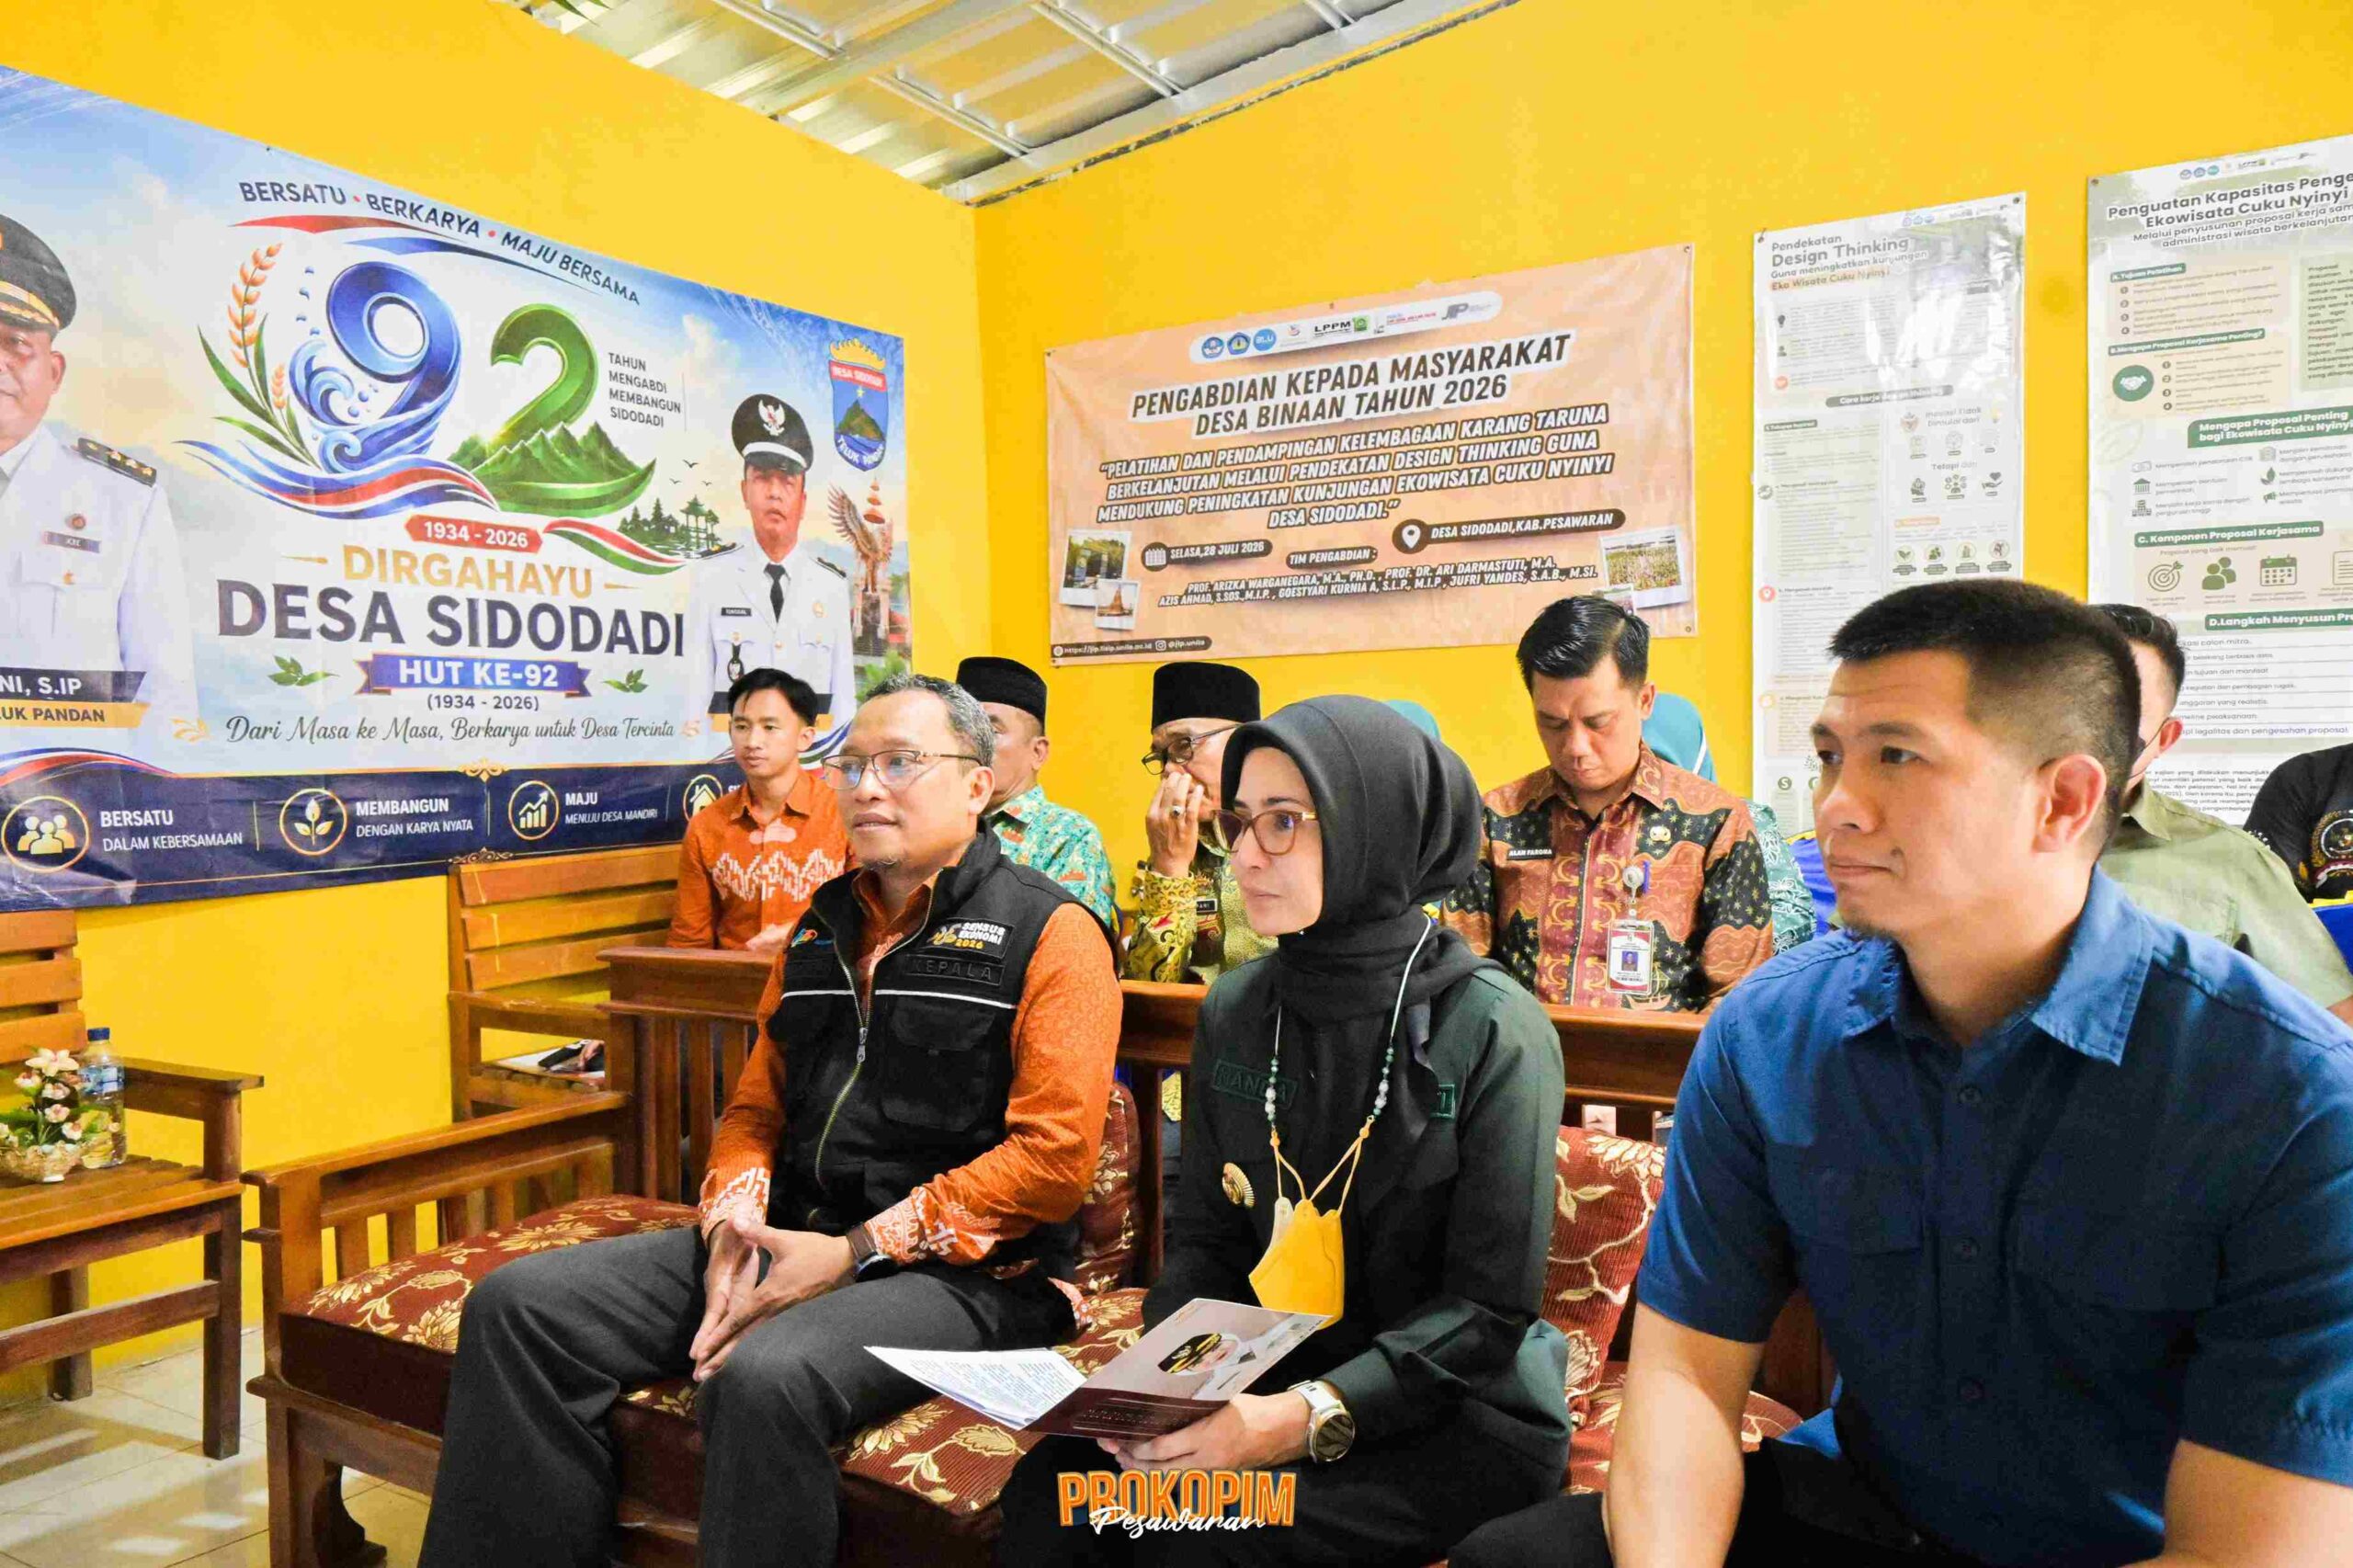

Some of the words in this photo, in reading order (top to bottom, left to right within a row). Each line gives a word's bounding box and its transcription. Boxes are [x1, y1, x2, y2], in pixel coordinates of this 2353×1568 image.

[2109, 197, 2201, 220] Penguatan
[2205, 183, 2295, 208] Kapasitas
[2145, 207, 2234, 229] Ekowisata
[2238, 199, 2286, 214] Cuku
[2290, 186, 2349, 210] Nyinyi
[2133, 229, 2172, 242] Melalui
[2174, 220, 2243, 238] penyusunan
[2245, 212, 2295, 229] proposal
[2297, 205, 2326, 221] kerja
[240, 181, 347, 207] BERSATU
[366, 193, 480, 238] BERKARYA
[501, 230, 557, 267] MAJU
[559, 254, 642, 306] BERSAMA
[1772, 235, 1842, 252] Pendekatan
[2162, 232, 2232, 247] administrasi
[2234, 225, 2272, 238] wisata
[1772, 250, 1828, 267] Design
[1833, 238, 1909, 258] Thinking
[1771, 269, 1797, 278] Guna
[608, 352, 646, 372] TAHUN
[608, 370, 667, 394] MENGABDI
[1131, 375, 1277, 418] PENGABDIAN
[1286, 361, 1379, 397] KEPADA
[1389, 334, 1571, 383] MASYARAKAT
[608, 388, 682, 414] MEMBANGUN
[1196, 410, 1247, 437] DESA
[1256, 395, 1346, 428] BINAAN
[1355, 383, 1436, 415] TAHUN
[1443, 374, 1507, 404] 2026
[609, 406, 665, 428] SIDODADI
[2200, 419, 2251, 433] Mengapa
[2253, 415, 2302, 428] Proposal
[2304, 410, 2348, 425] Penting
[1183, 455, 1213, 471] DAN
[1216, 437, 1336, 465] PENDAMPINGAN
[1339, 426, 1455, 453] KELEMBAGAAN
[1460, 414, 1529, 440] KARANG
[1536, 404, 1608, 428] TARUNA
[2200, 429, 2224, 442] bagi
[2226, 426, 2282, 439] Ekowisata
[2284, 424, 2314, 435] Cuku
[1108, 472, 1219, 500] BERKELANJUTAN
[1223, 464, 1284, 488] MELALUI
[1288, 454, 1389, 481] PENDEKATAN
[1393, 447, 1453, 470] DESIGN
[1458, 438, 1541, 462] THINKING
[1546, 431, 1597, 452] GUNA
[1097, 498, 1183, 523] MENDUKUNG
[1188, 487, 1287, 514] PENINGKATAN
[1292, 479, 1392, 504] KUNJUNGAN
[1395, 466, 1489, 494] EKOWISATA
[1495, 461, 1543, 483] CUKU
[1548, 454, 1614, 477] NYINYI
[1268, 508, 1305, 528] DESA
[424, 521, 470, 542] 1934
[485, 527, 529, 548] 2026
[1431, 527, 1458, 540] DESA
[2151, 532, 2208, 546] Komponen
[2209, 528, 2256, 541] Proposal
[2258, 524, 2320, 540] Kerjasama
[1218, 544, 1239, 555] JULI
[1241, 541, 1265, 552] 2026
[1290, 553, 1306, 565] TIM
[1309, 549, 1370, 563] PENGABDIAN
[342, 544, 593, 598] DIRGAHAYU
[1415, 566, 1433, 576] DR.
[1436, 564, 1454, 575] ARI
[217, 579, 405, 644] DESA
[426, 596, 684, 657] SIDODADI
[2272, 614, 2336, 627] Menyusun
[398, 659, 469, 687] HUT
[472, 659, 559, 687] KE-92
[38, 676, 82, 695] S.IP
[427, 694, 474, 711] (1934
[493, 694, 540, 711] 2026)
[0, 706, 28, 721] UK
[32, 707, 105, 722] PANDAN
[226, 715, 282, 743] Dari
[291, 717, 350, 742] Masa
[356, 720, 378, 740] ke
[383, 717, 445, 742] Masa,
[451, 716, 531, 747] Berkarya
[535, 719, 575, 739] untuk
[580, 718, 619, 739] Desa
[621, 717, 675, 738] Tercinta
[356, 798, 449, 816] MEMBANGUN
[565, 791, 597, 806] MAJU
[100, 810, 174, 827] BERSATU
[564, 811, 597, 824] MENUJU
[600, 809, 622, 823] DESA
[624, 807, 658, 821] MANDIRI
[356, 821, 402, 837] DENGAN
[404, 820, 439, 835] KARYA
[441, 818, 473, 834] NYATA
[103, 837, 150, 852] DALAM
[152, 832, 244, 849] KEBERSAMAAN
[958, 930, 1003, 946] EKONOMI
[961, 922, 1006, 937] SENSUS
[955, 938, 985, 949] 2026
